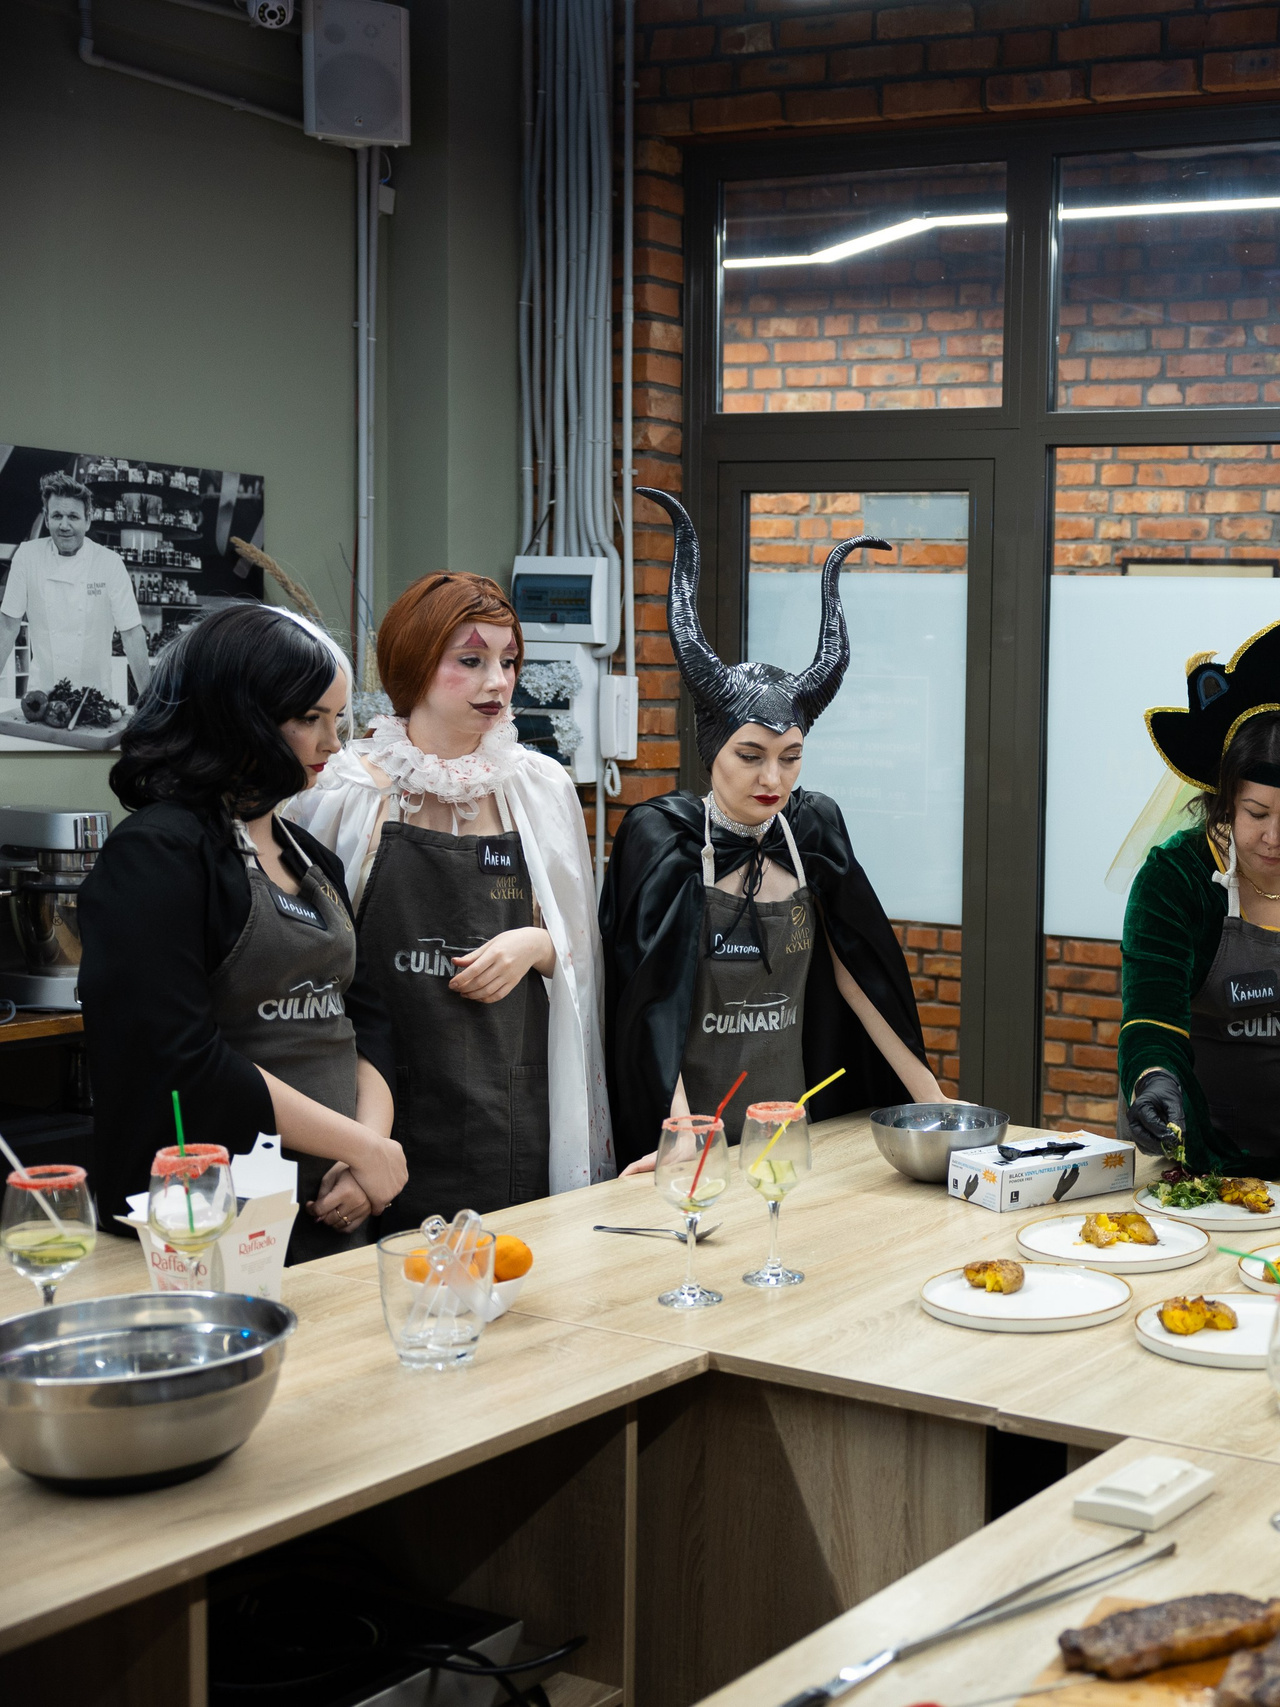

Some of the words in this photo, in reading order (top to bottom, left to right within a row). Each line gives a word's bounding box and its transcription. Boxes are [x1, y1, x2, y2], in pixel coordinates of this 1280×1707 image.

[495, 876, 518, 889] МИР
[490, 888, 525, 900] КУХНИ
[790, 927, 810, 942] МИР
[394, 949, 461, 977] CULIN
[1230, 981, 1274, 1003] Камила
[1009, 1172, 1024, 1180] BLACK
[1024, 1165, 1056, 1177] VINYL/NITRILE
[1056, 1163, 1072, 1172] BLEND
[239, 1236, 276, 1255] Raffaello
[151, 1251, 208, 1276] Raffao
